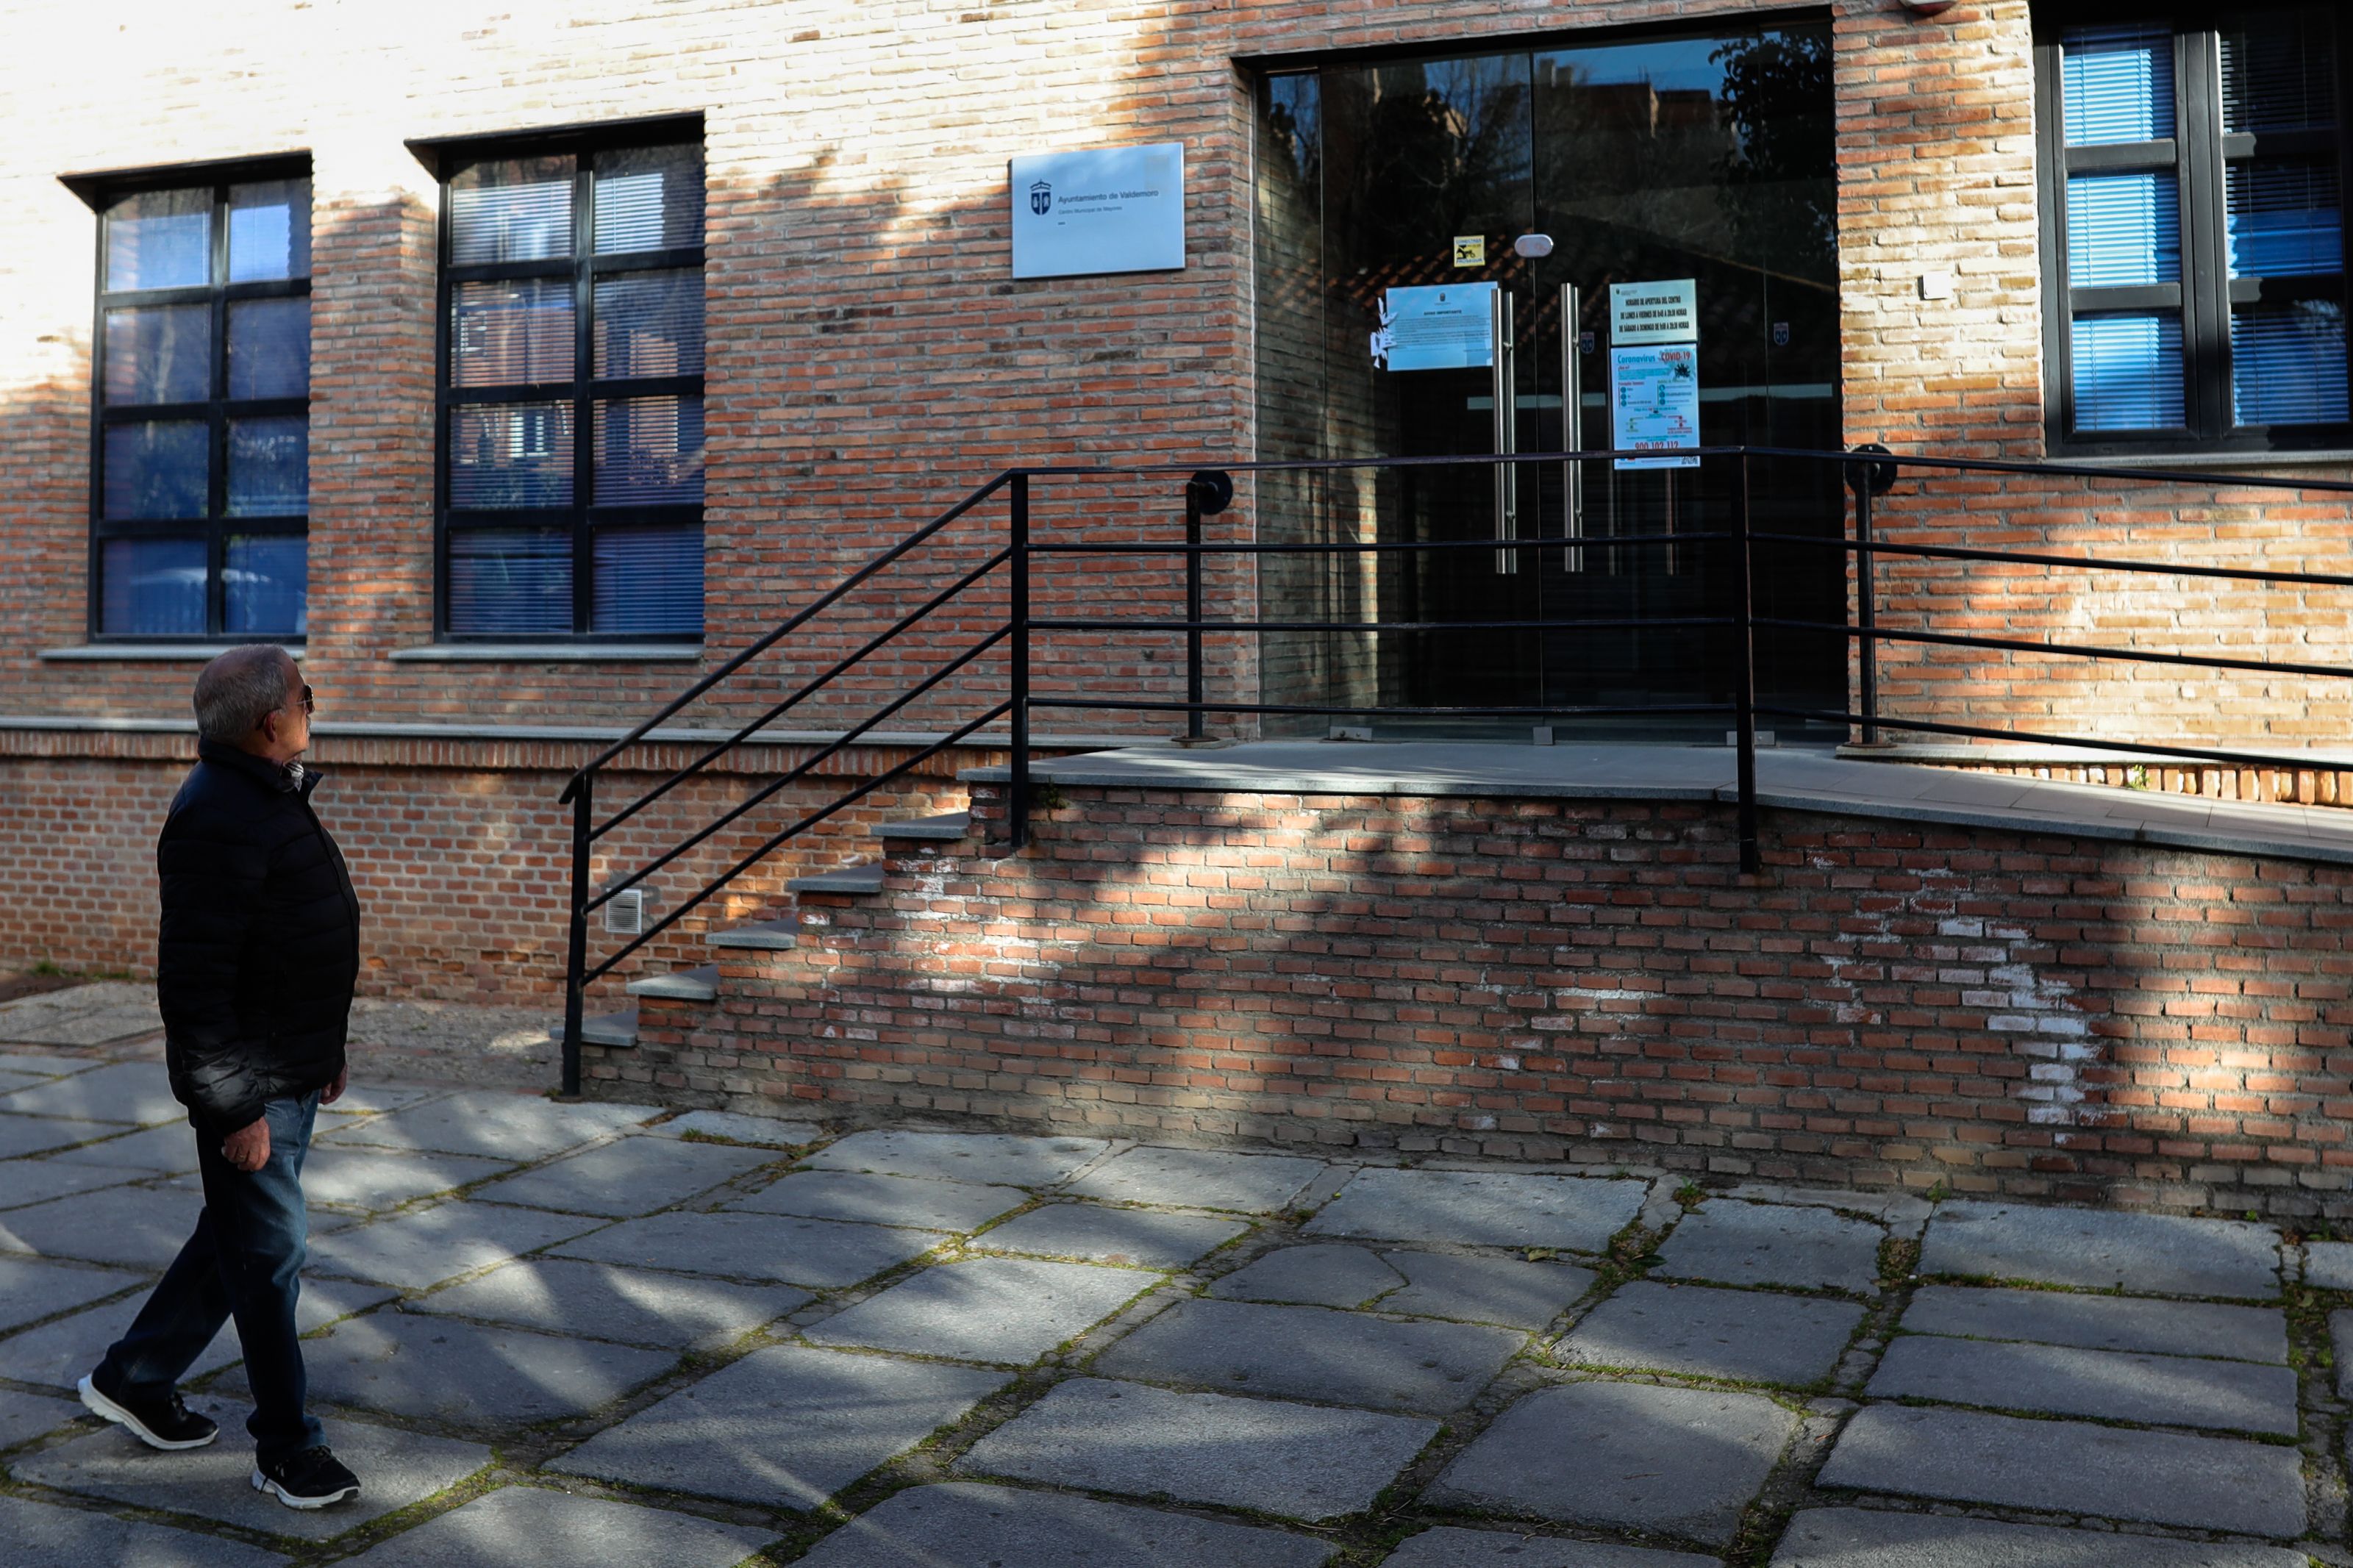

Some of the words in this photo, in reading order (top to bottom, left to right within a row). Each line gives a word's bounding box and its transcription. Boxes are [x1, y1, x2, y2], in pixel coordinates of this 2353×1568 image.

[1058, 194, 1107, 204] Ayuntamiento
[1120, 190, 1159, 198] Valdemoro
[1626, 298, 1639, 306] HORARIO
[1640, 298, 1644, 306] DE
[1645, 296, 1661, 305] APERTURA
[1668, 295, 1681, 304] CENTRO
[1625, 310, 1635, 319] LUNES
[1639, 309, 1652, 318] VIERNES
[1640, 323, 1654, 332] DOMINGO
[1618, 354, 1656, 364] Coronavirus
[1635, 442, 1649, 450] 900
[1652, 441, 1663, 449] 102
[1667, 440, 1679, 448] 112
